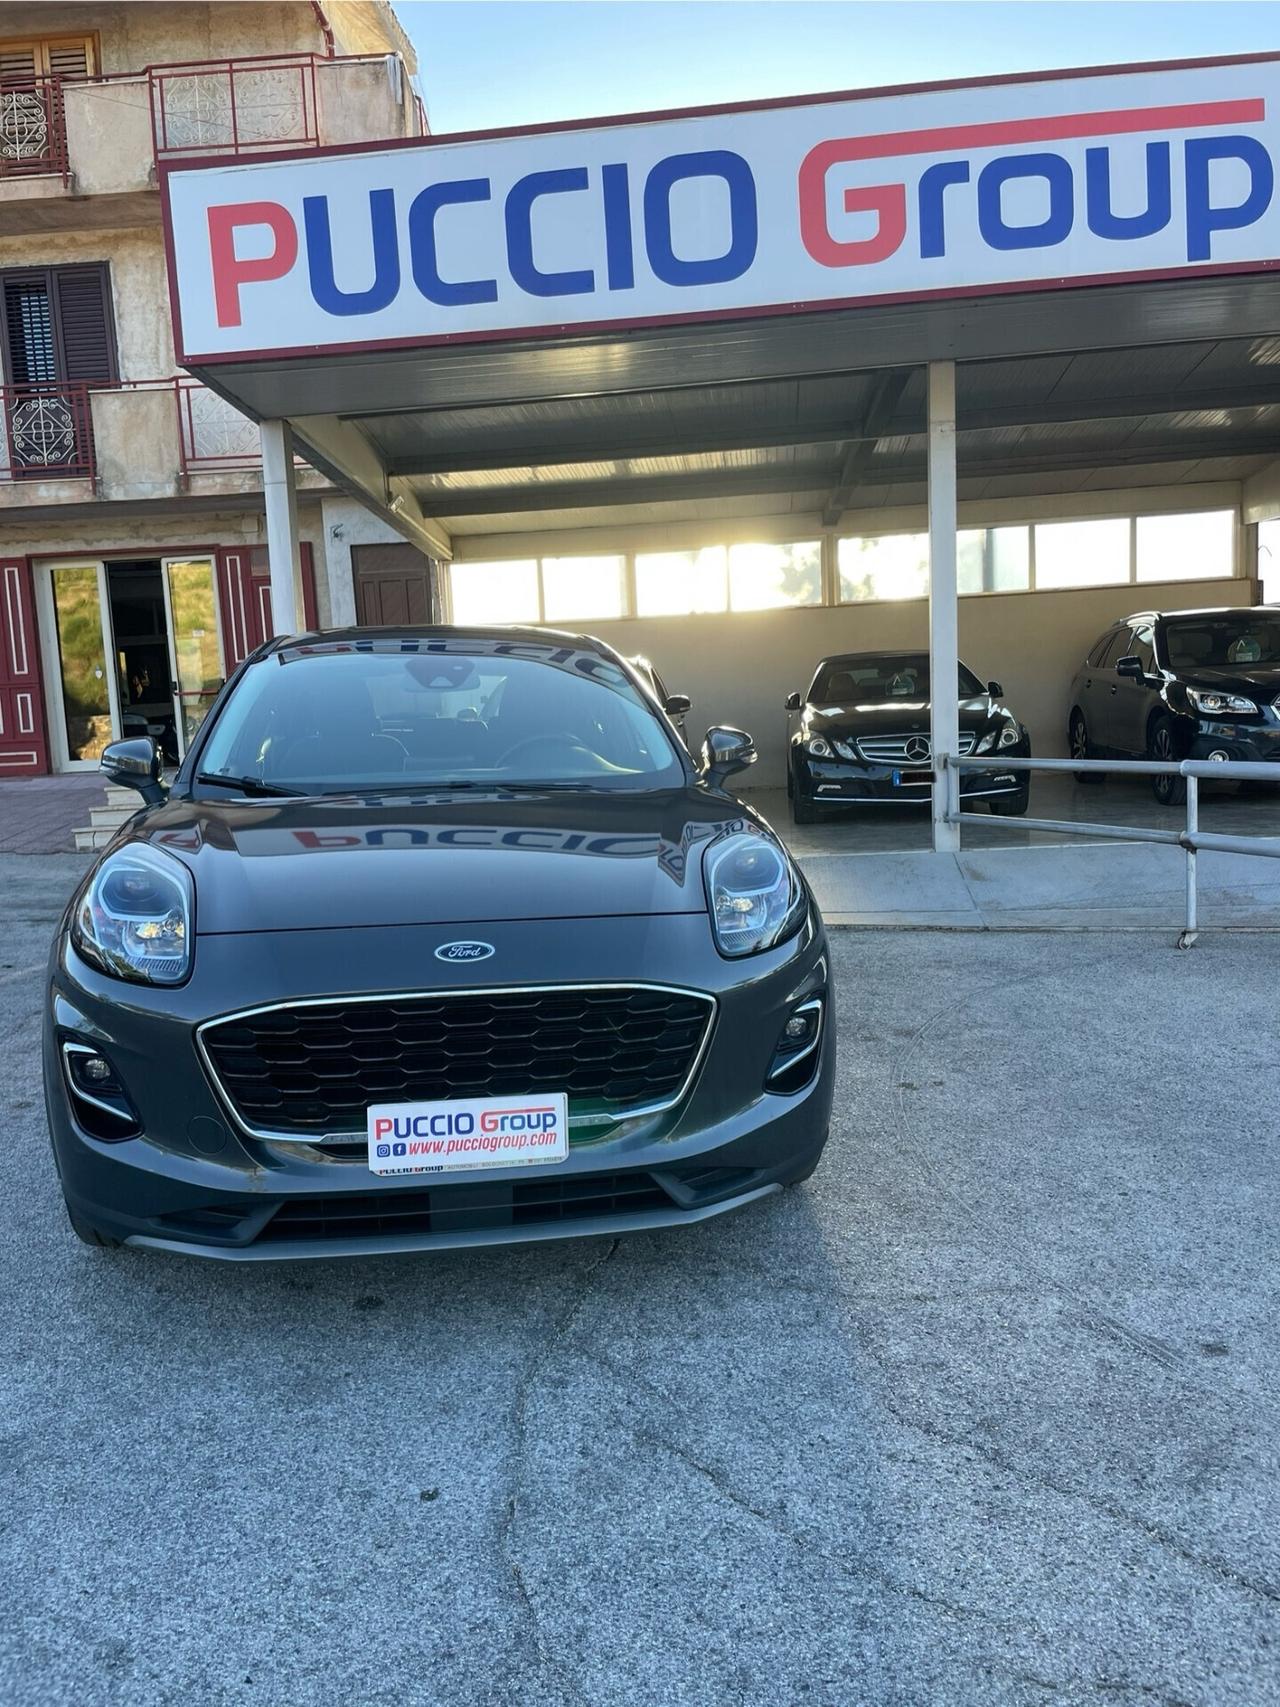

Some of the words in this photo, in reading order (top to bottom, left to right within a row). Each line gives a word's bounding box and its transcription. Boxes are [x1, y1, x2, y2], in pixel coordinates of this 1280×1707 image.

[206, 149, 758, 329] PUCCIO
[798, 97, 1274, 268] Group
[448, 945, 481, 957] Ford
[375, 1113, 474, 1140] PUCCIO
[480, 1107, 557, 1133] Group
[408, 1129, 557, 1156] www.pucciogroup.com
